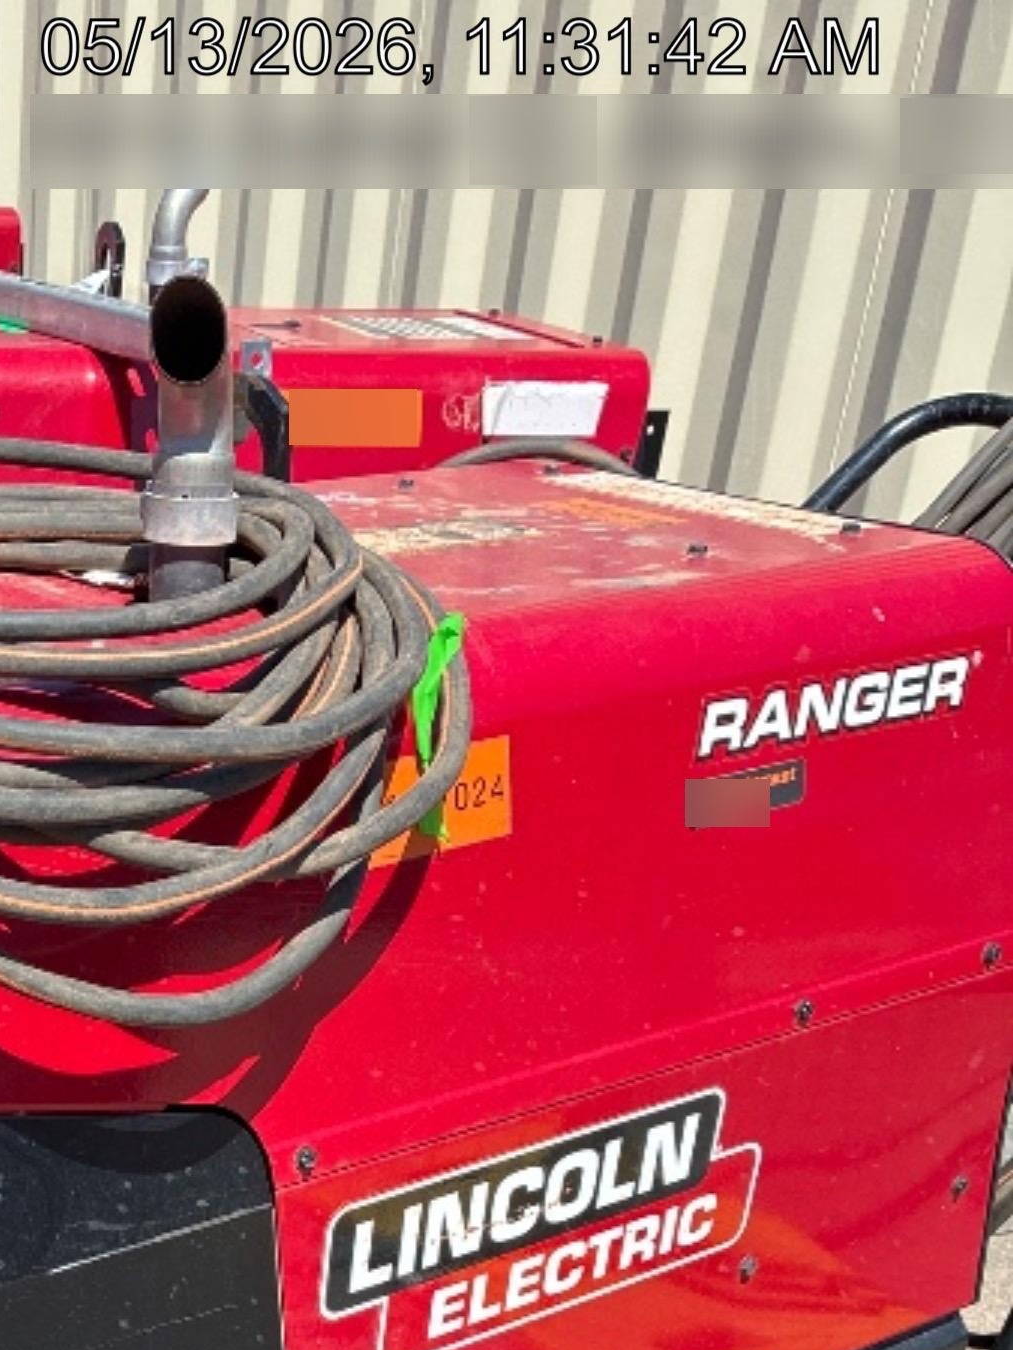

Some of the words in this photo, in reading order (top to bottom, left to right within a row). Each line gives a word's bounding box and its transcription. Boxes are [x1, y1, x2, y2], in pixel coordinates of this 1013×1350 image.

[696, 656, 970, 758] RANGER
[348, 1112, 701, 1295] LINCOLN
[426, 1192, 718, 1340] ELECTRIC
